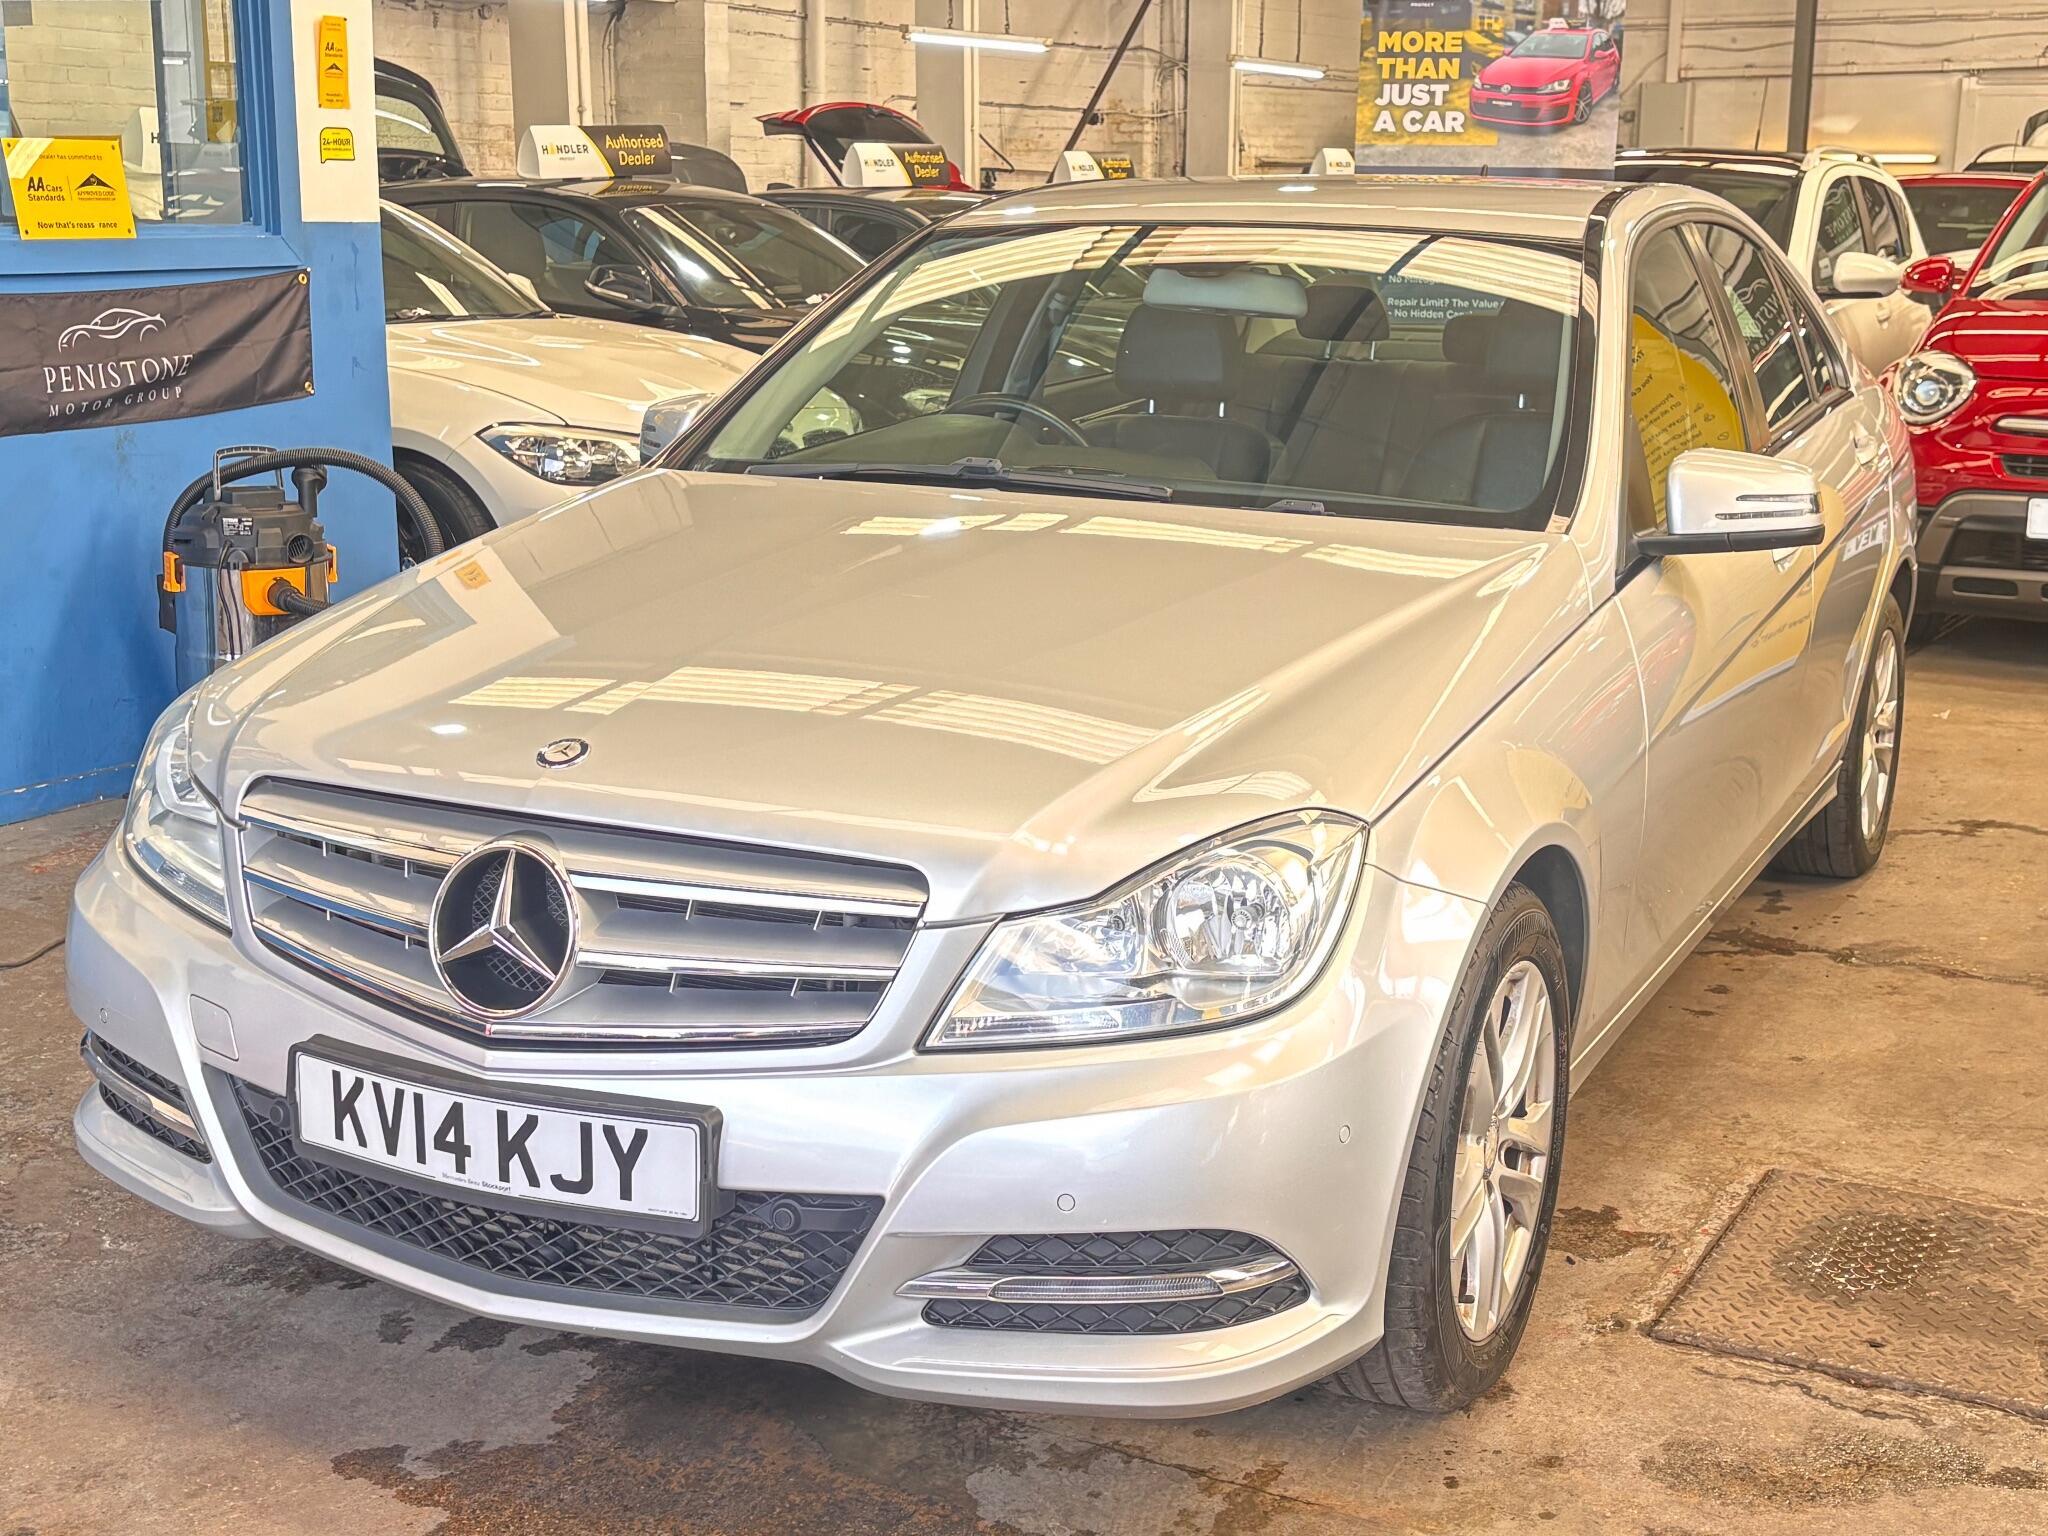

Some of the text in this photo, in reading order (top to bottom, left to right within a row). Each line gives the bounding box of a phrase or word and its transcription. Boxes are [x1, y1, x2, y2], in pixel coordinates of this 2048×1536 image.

[325, 42, 335, 51] AA
[1378, 31, 1463, 53] MORE
[1377, 58, 1460, 80] THAN
[1374, 83, 1450, 106] JUST
[1372, 110, 1465, 132] A CAR
[322, 137, 350, 146] 24-HOUR
[605, 133, 664, 149] Authorised
[619, 150, 655, 166] Dealer
[904, 151, 945, 164] Authorised
[914, 165, 939, 178] Dealer
[27, 176, 63, 192] AA Cars
[27, 193, 66, 202] Standards
[37, 221, 54, 229] Now
[55, 220, 75, 229] that's
[1388, 275, 1402, 283] No
[1387, 297, 1498, 309] Repair Limit? The Value
[1394, 309, 1408, 318] No
[1410, 309, 1444, 319] Hidden
[43, 354, 193, 394] PENISTONE
[49, 386, 183, 417] MOTOR GROUP
[332, 1069, 649, 1202] KV14 KJY
[481, 1180, 511, 1192] Stockport
